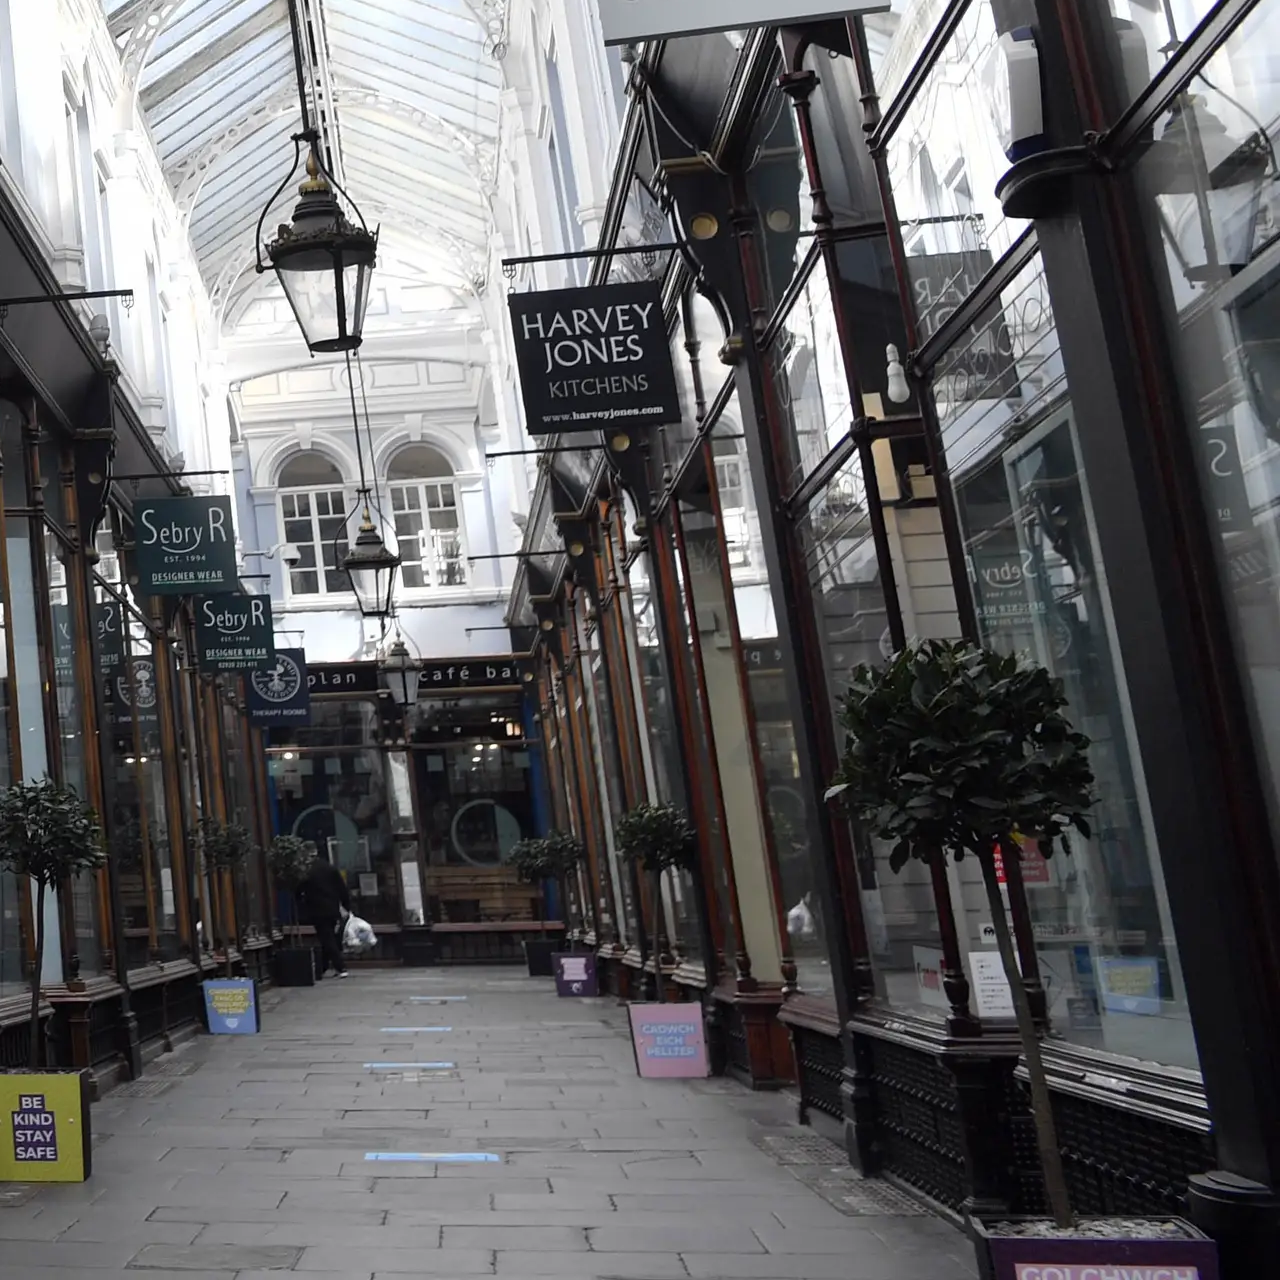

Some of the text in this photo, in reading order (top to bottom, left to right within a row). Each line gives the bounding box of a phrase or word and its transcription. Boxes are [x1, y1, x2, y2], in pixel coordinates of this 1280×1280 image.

[521, 302, 653, 340] HARVEY
[544, 334, 644, 374] JONES
[549, 374, 649, 399] KITCHENS
[542, 405, 664, 423] www.harveyjones.com
[142, 507, 228, 554] Sebry R
[151, 570, 224, 582] DESIGNER WEAR
[203, 599, 265, 634] Sebry R
[206, 648, 268, 658] DESIGNER WEAR
[419, 665, 470, 682] café
[21, 1096, 43, 1109] BE
[14, 1112, 53, 1126] KIND
[15, 1129, 53, 1143] STAY
[16, 1145, 56, 1160] SAFE
